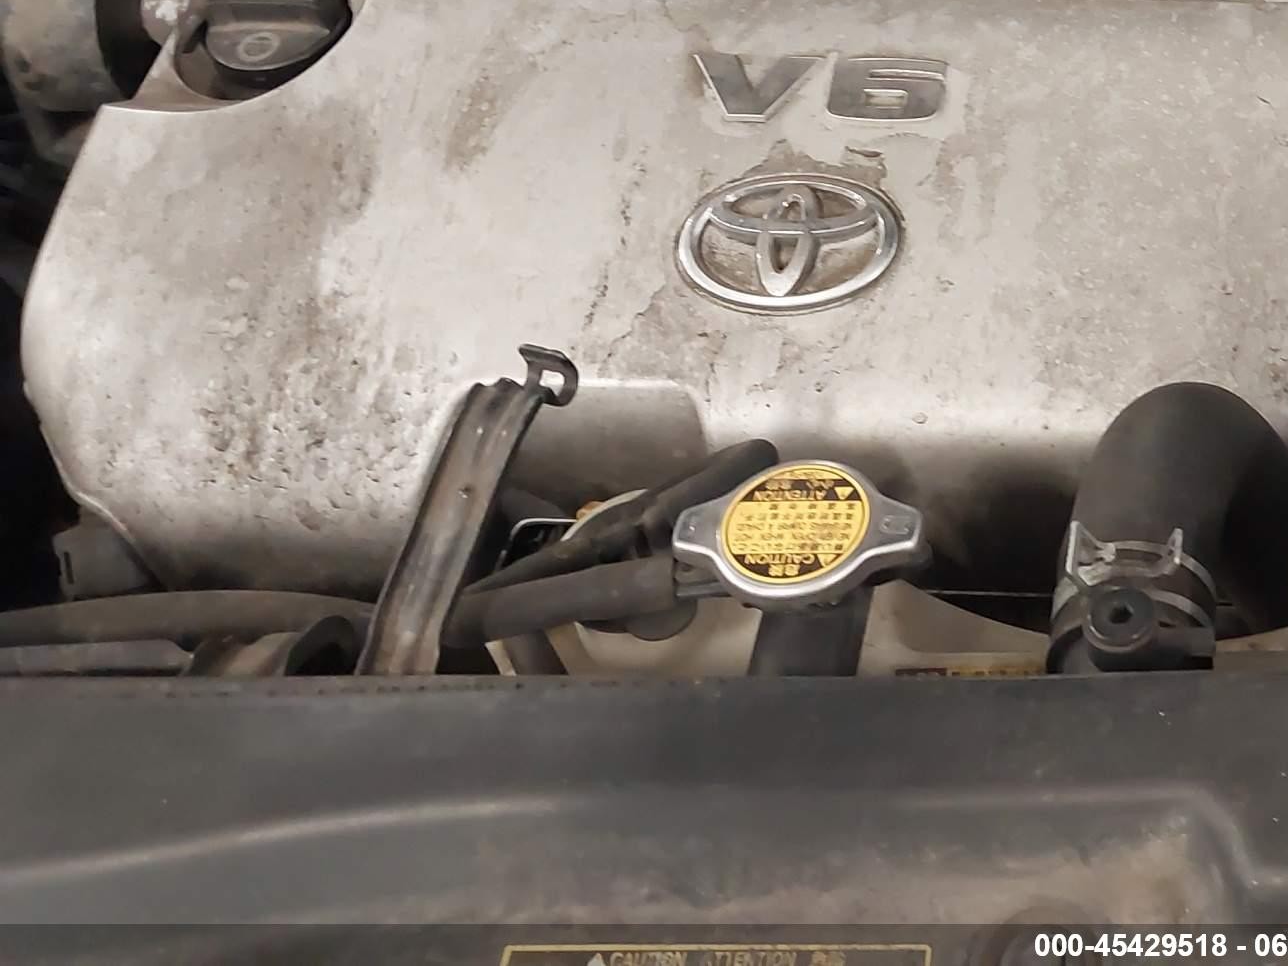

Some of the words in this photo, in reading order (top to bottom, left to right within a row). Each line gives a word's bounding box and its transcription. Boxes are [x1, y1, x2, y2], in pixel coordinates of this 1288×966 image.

[692, 52, 950, 124] V6
[753, 490, 827, 501] ATTENTION
[744, 553, 815, 565] CAUTION
[610, 951, 687, 966] CAUTION
